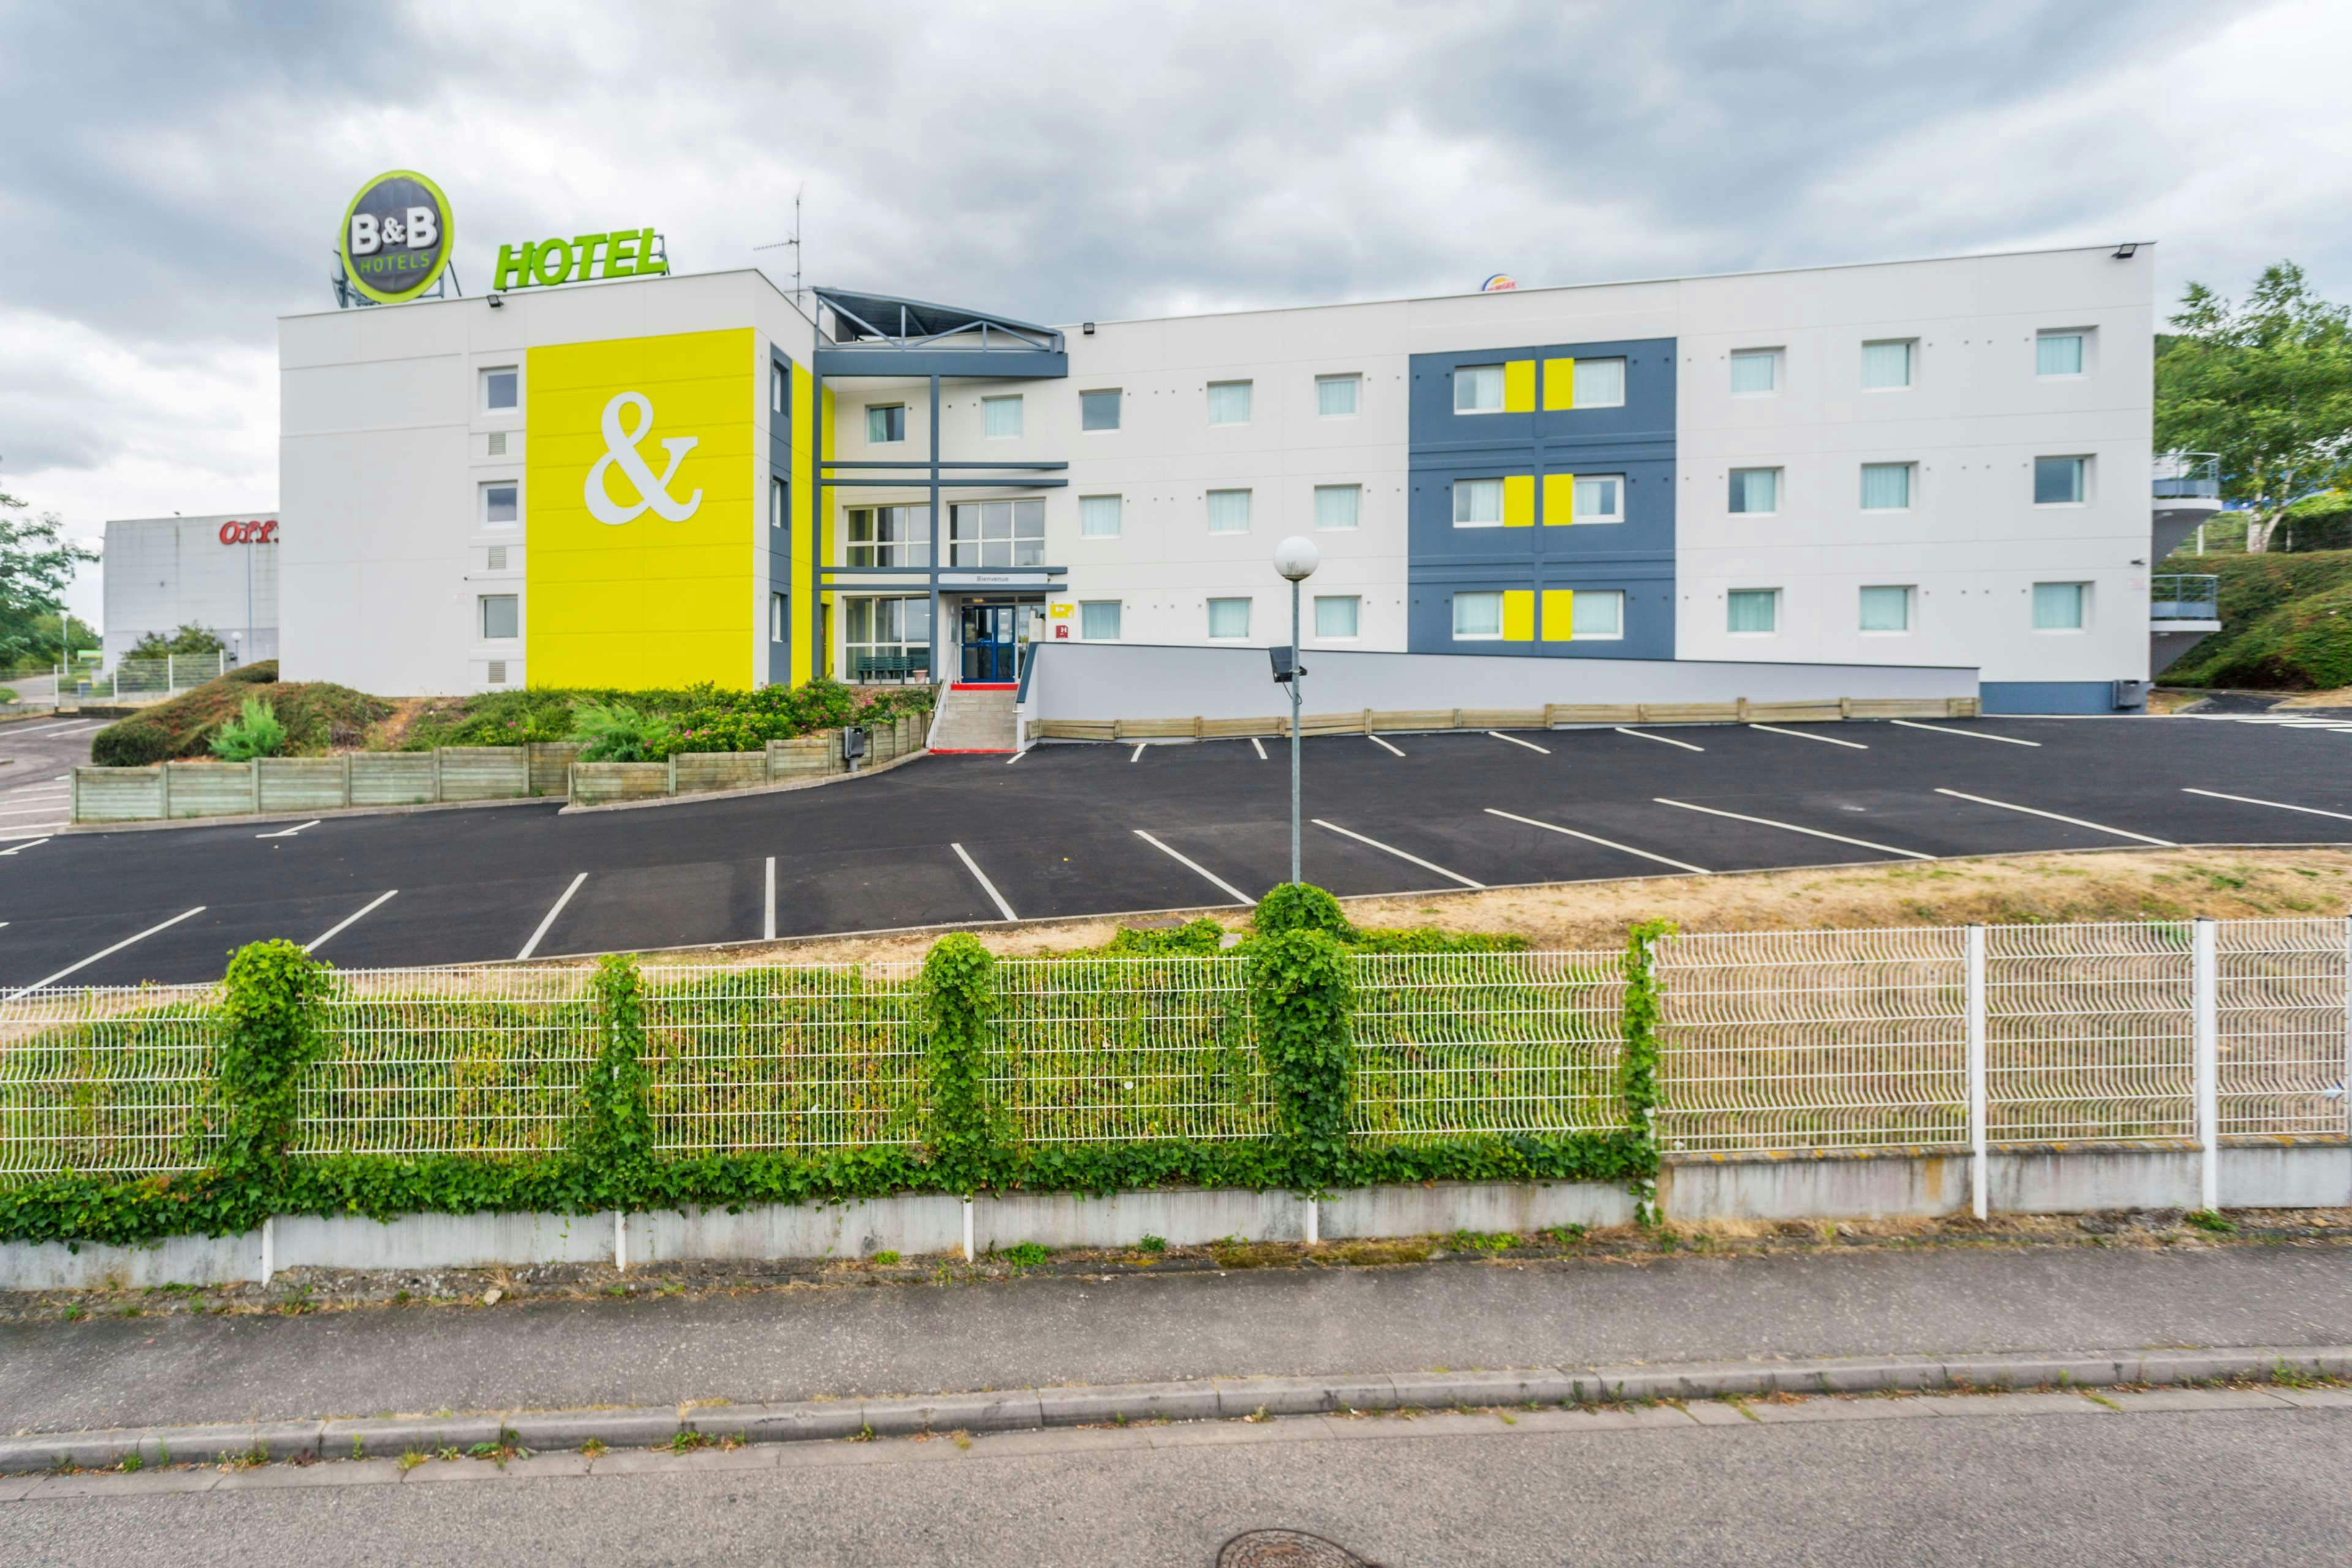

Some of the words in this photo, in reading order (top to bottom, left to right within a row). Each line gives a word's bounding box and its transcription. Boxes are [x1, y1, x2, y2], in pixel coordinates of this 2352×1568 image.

[352, 206, 439, 255] B&B
[360, 251, 430, 274] HOTELS
[493, 227, 666, 290] HOTEL
